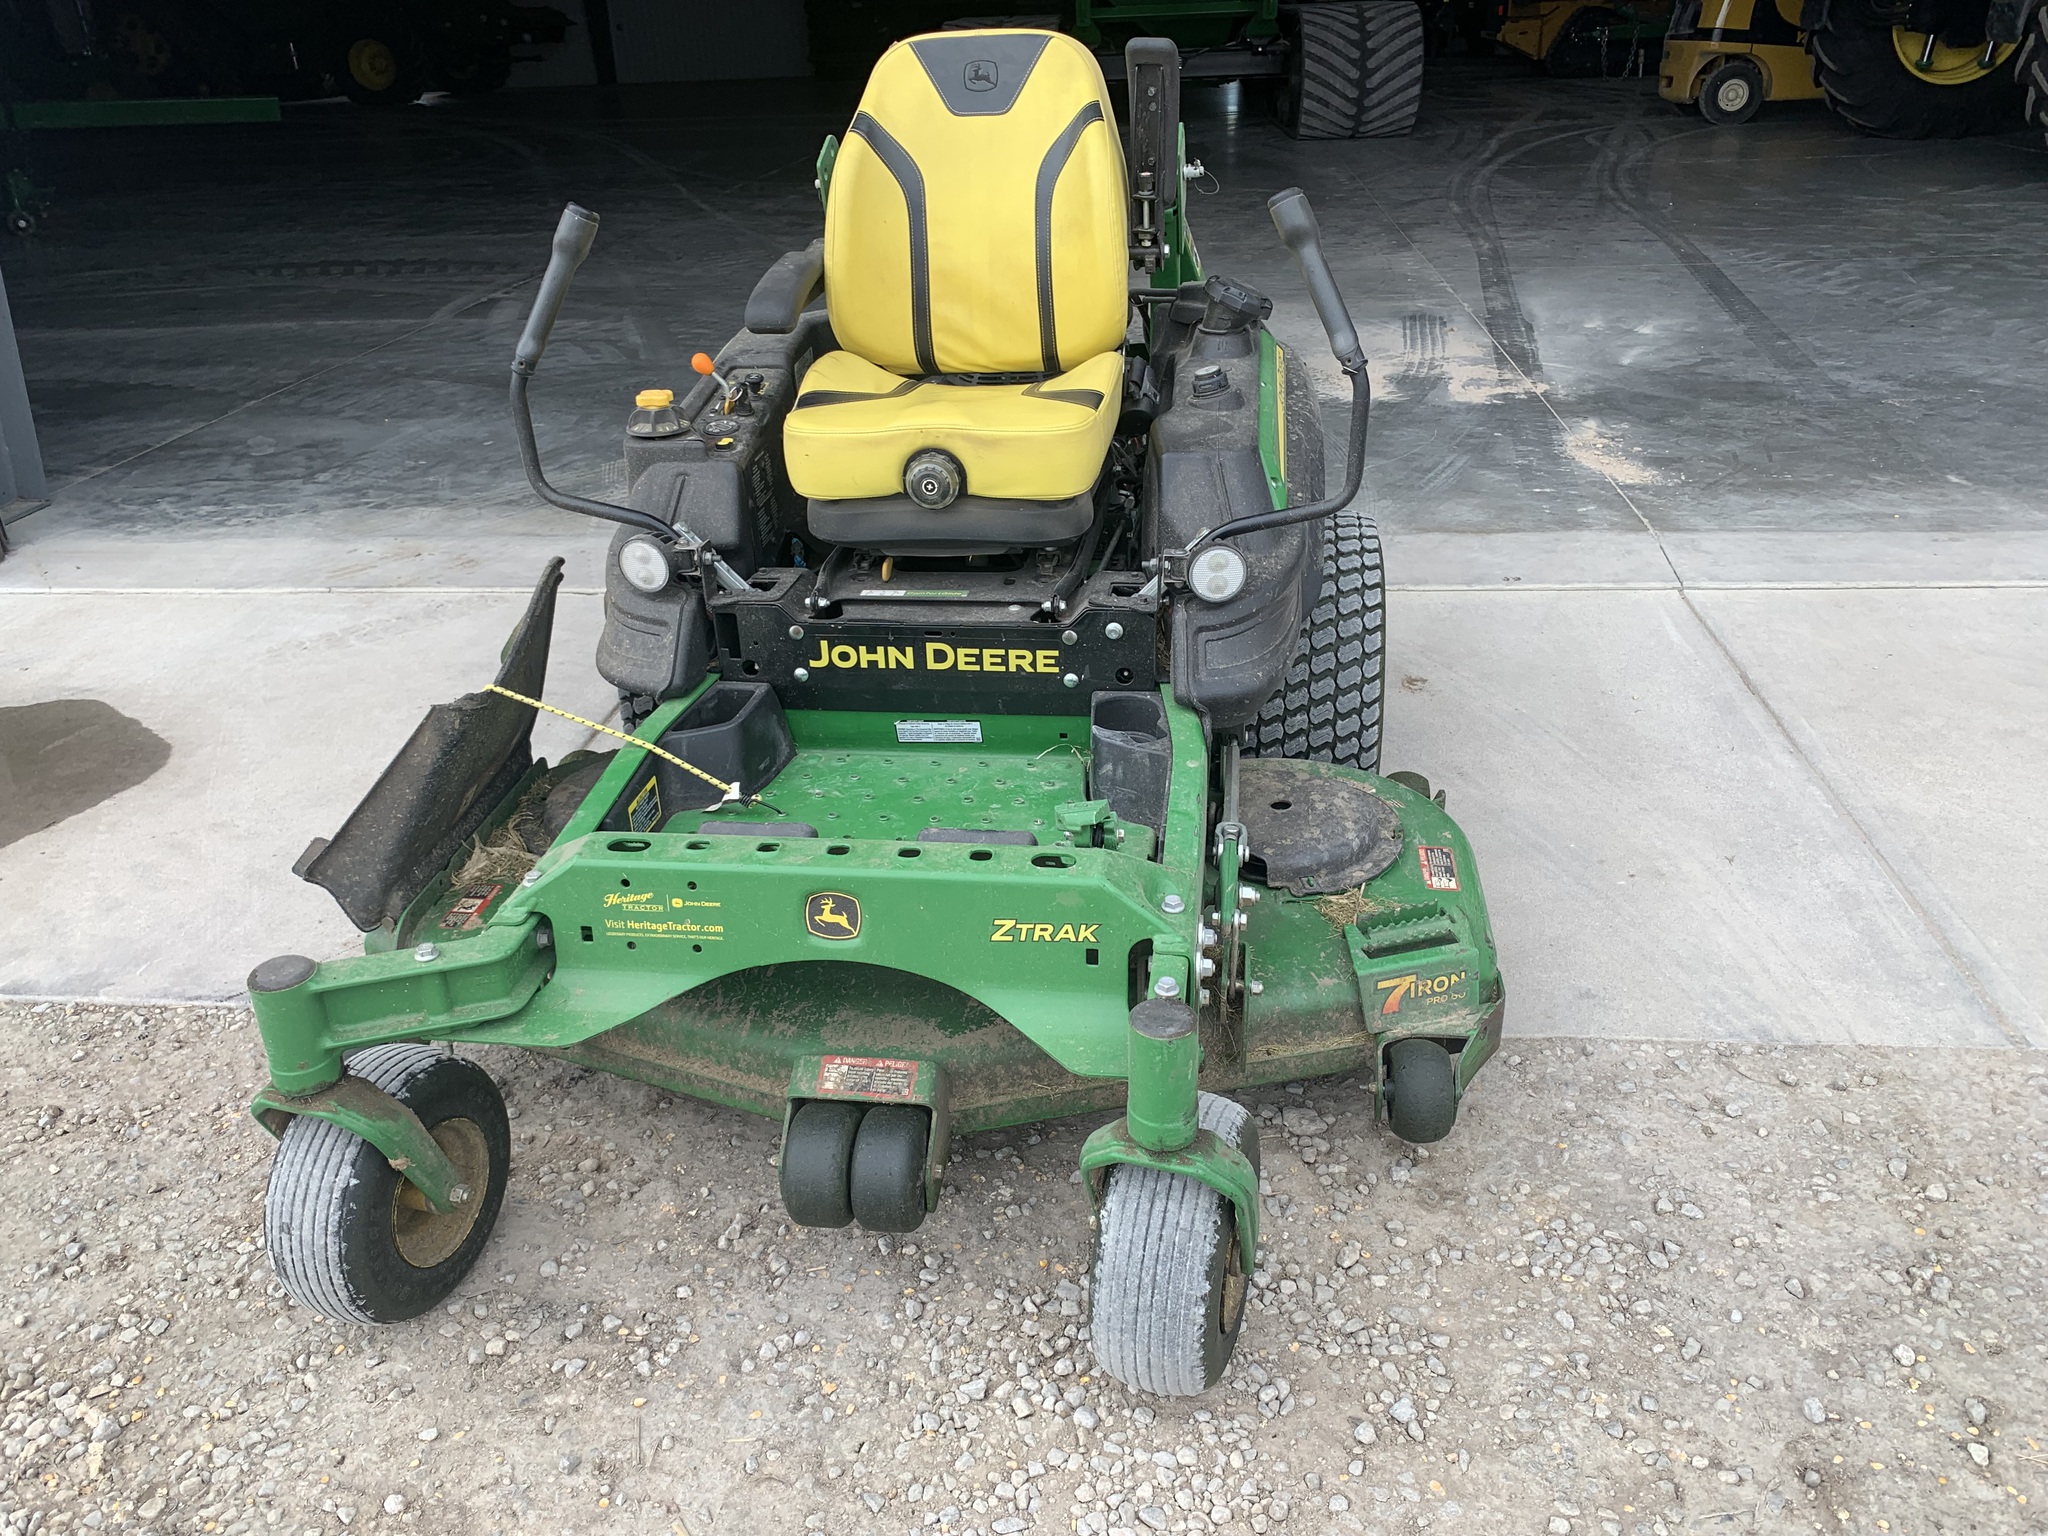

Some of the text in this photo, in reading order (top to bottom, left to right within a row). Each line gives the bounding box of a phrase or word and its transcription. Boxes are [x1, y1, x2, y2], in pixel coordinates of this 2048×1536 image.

[809, 640, 1060, 673] JOHN DEERE
[603, 892, 654, 907] Heritage
[622, 904, 664, 912] TRACTOR
[604, 919, 724, 932] Visit HeritageTractor.com
[990, 918, 1102, 943] ZTRAK
[1426, 995, 1448, 1006] PRO
